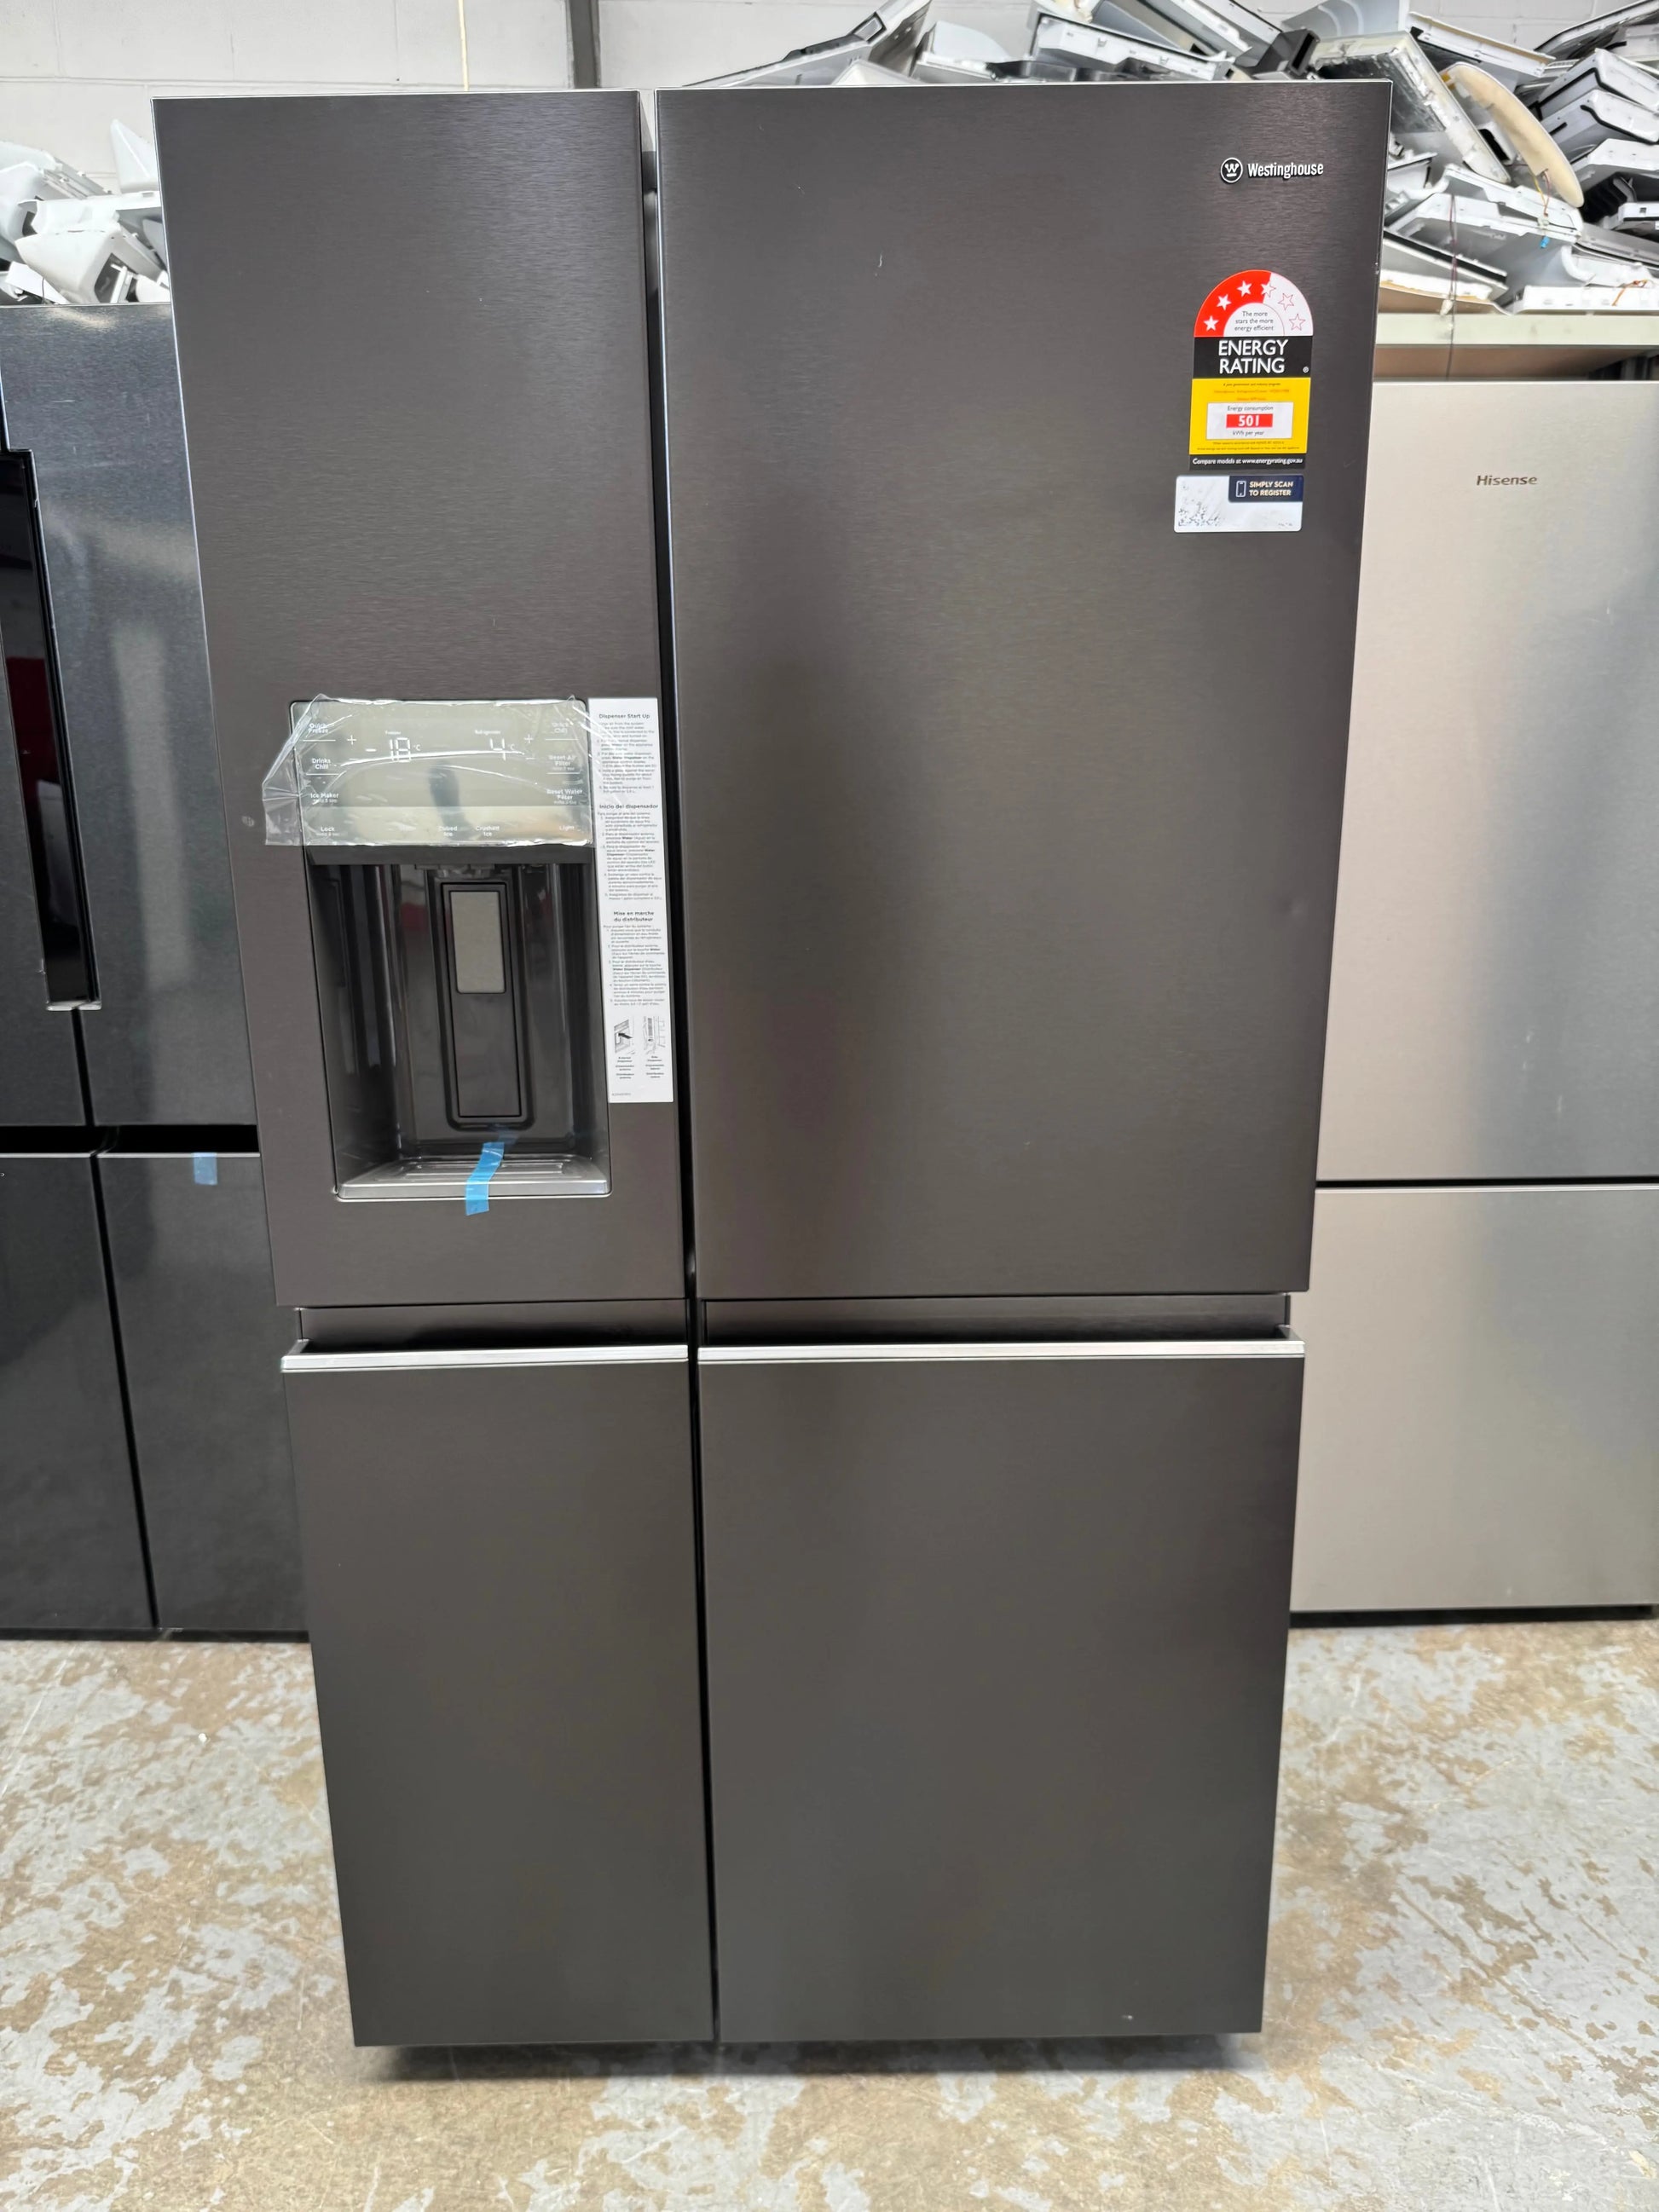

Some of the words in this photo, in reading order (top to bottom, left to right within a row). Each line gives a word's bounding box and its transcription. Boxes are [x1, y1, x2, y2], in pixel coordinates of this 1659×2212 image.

[1247, 162, 1324, 179] Westinghouse
[1218, 338, 1289, 356] ENERGY
[1219, 357, 1285, 374] RATING
[1238, 414, 1260, 427] 501
[1477, 475, 1538, 486] Hisense
